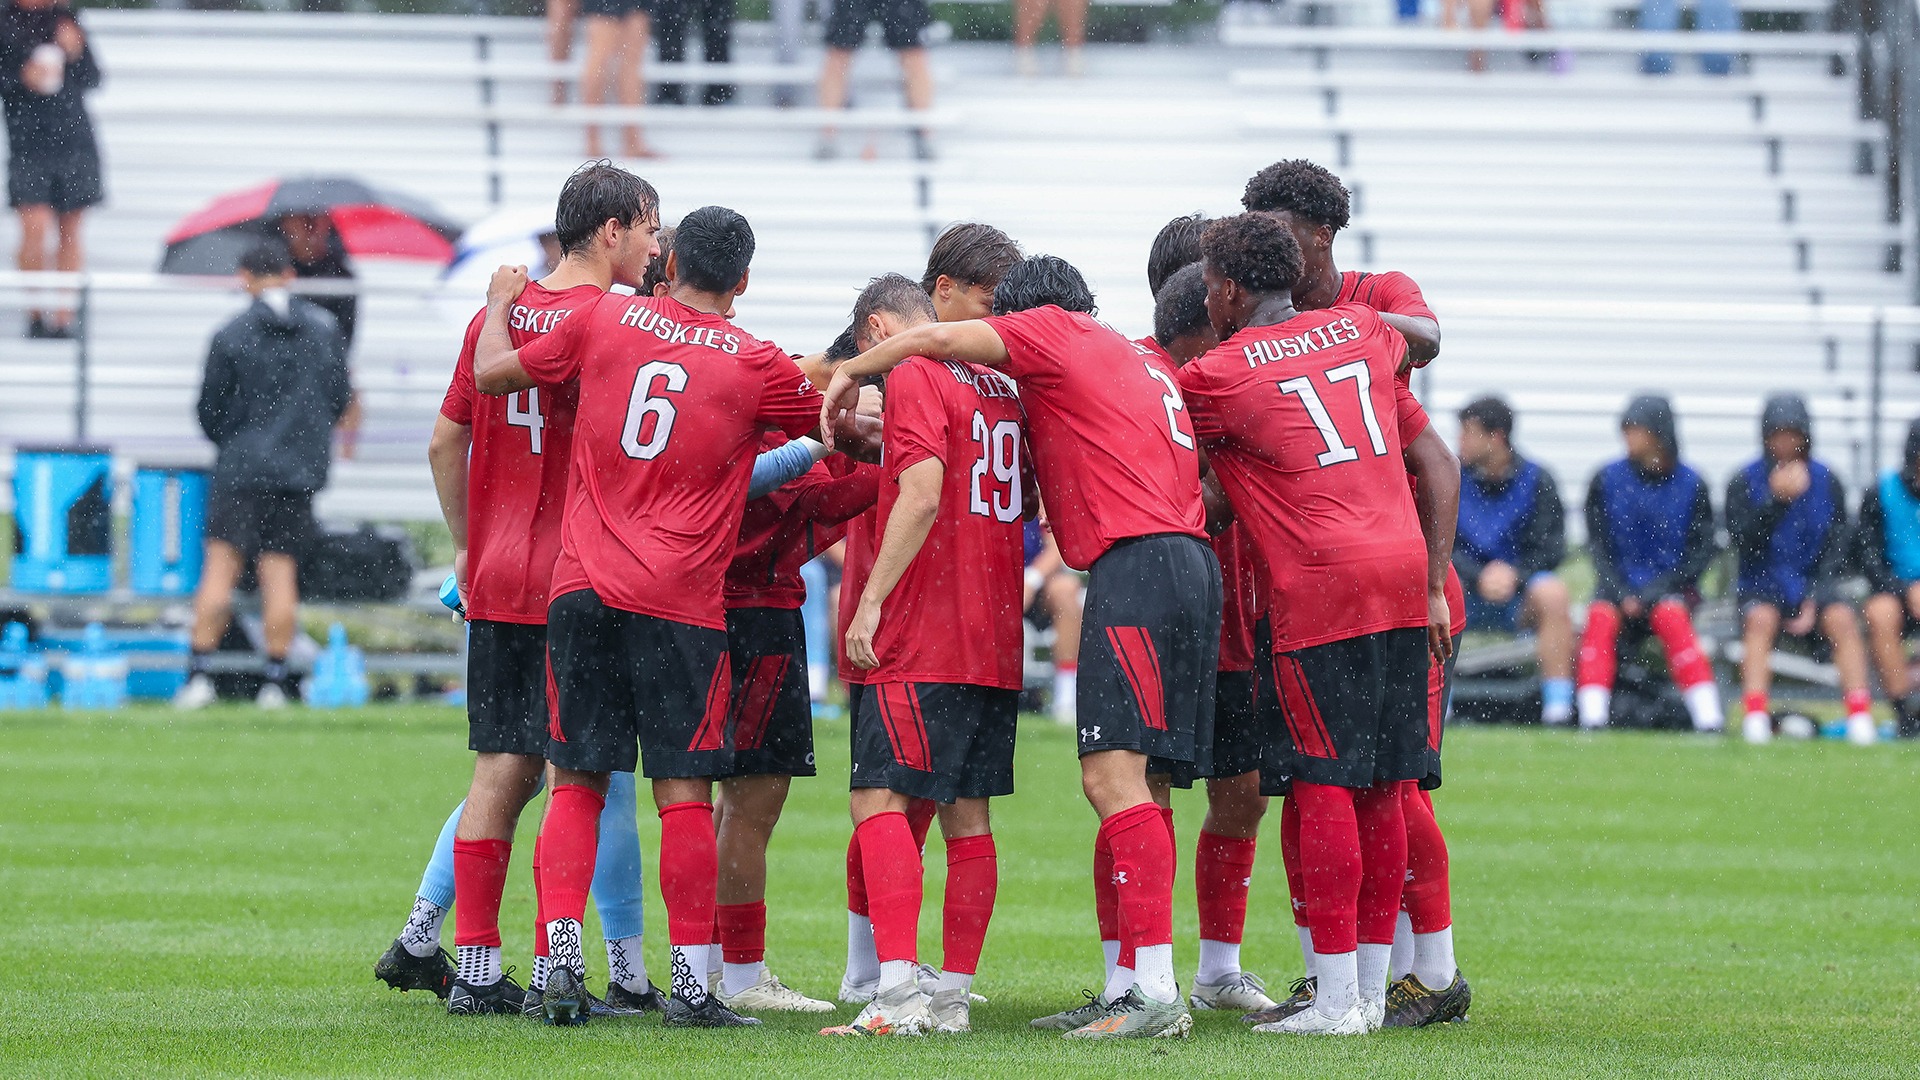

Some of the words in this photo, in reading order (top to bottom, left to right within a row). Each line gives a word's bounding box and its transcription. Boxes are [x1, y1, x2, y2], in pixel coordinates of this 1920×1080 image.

[508, 303, 574, 334] SKIE
[619, 303, 741, 355] HUSKIES
[1242, 316, 1361, 369] HUSKIES
[506, 386, 545, 455] 4
[620, 360, 690, 461] 6
[1276, 359, 1388, 468] 17
[969, 409, 1024, 524] 29
